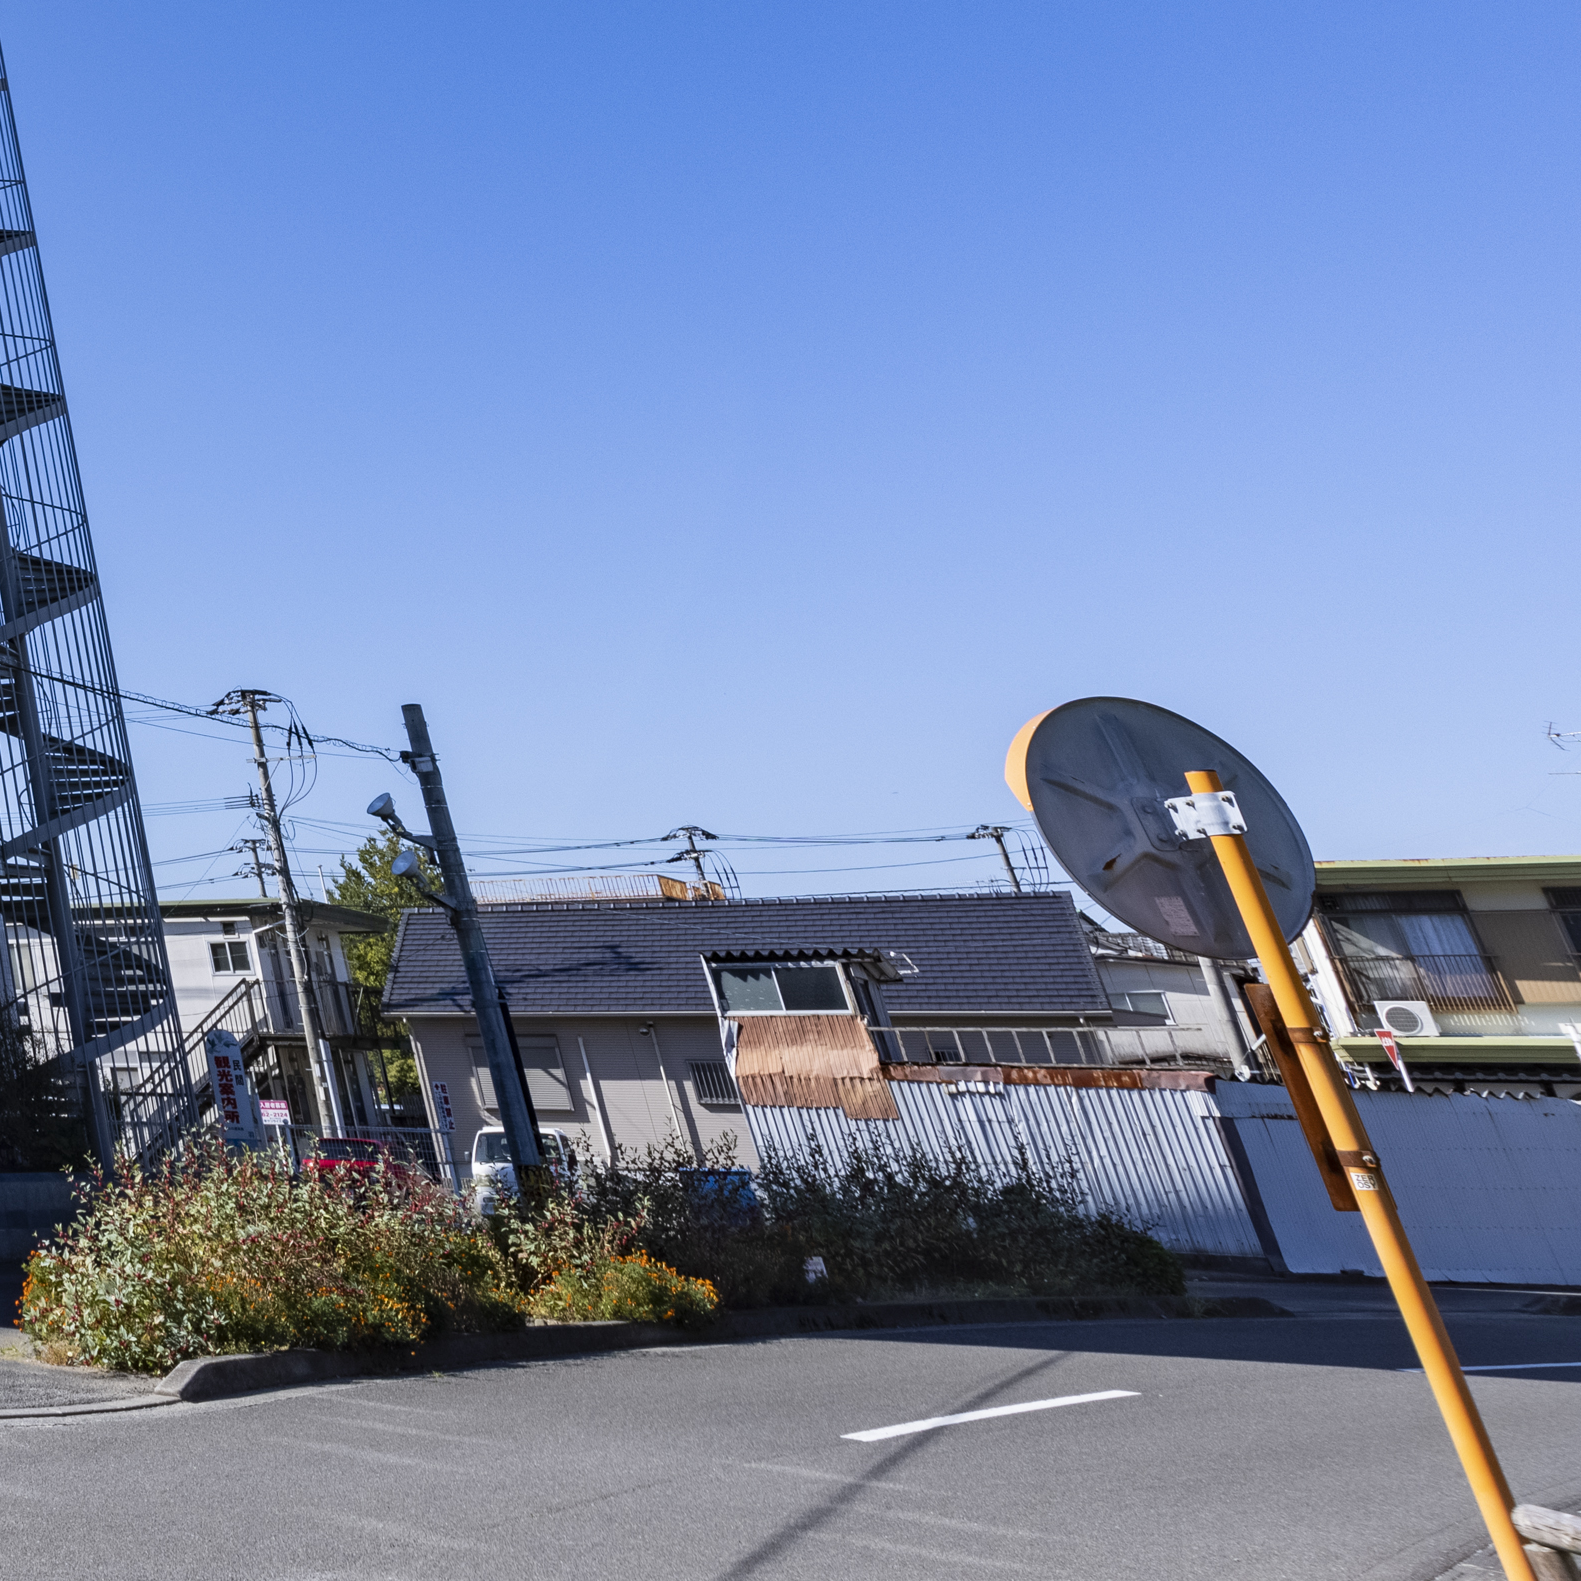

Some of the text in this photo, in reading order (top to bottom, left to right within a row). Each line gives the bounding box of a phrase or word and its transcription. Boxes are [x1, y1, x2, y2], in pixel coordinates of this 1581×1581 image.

[214, 1055, 241, 1124] 観光案内所
[232, 1059, 244, 1086] 民間
